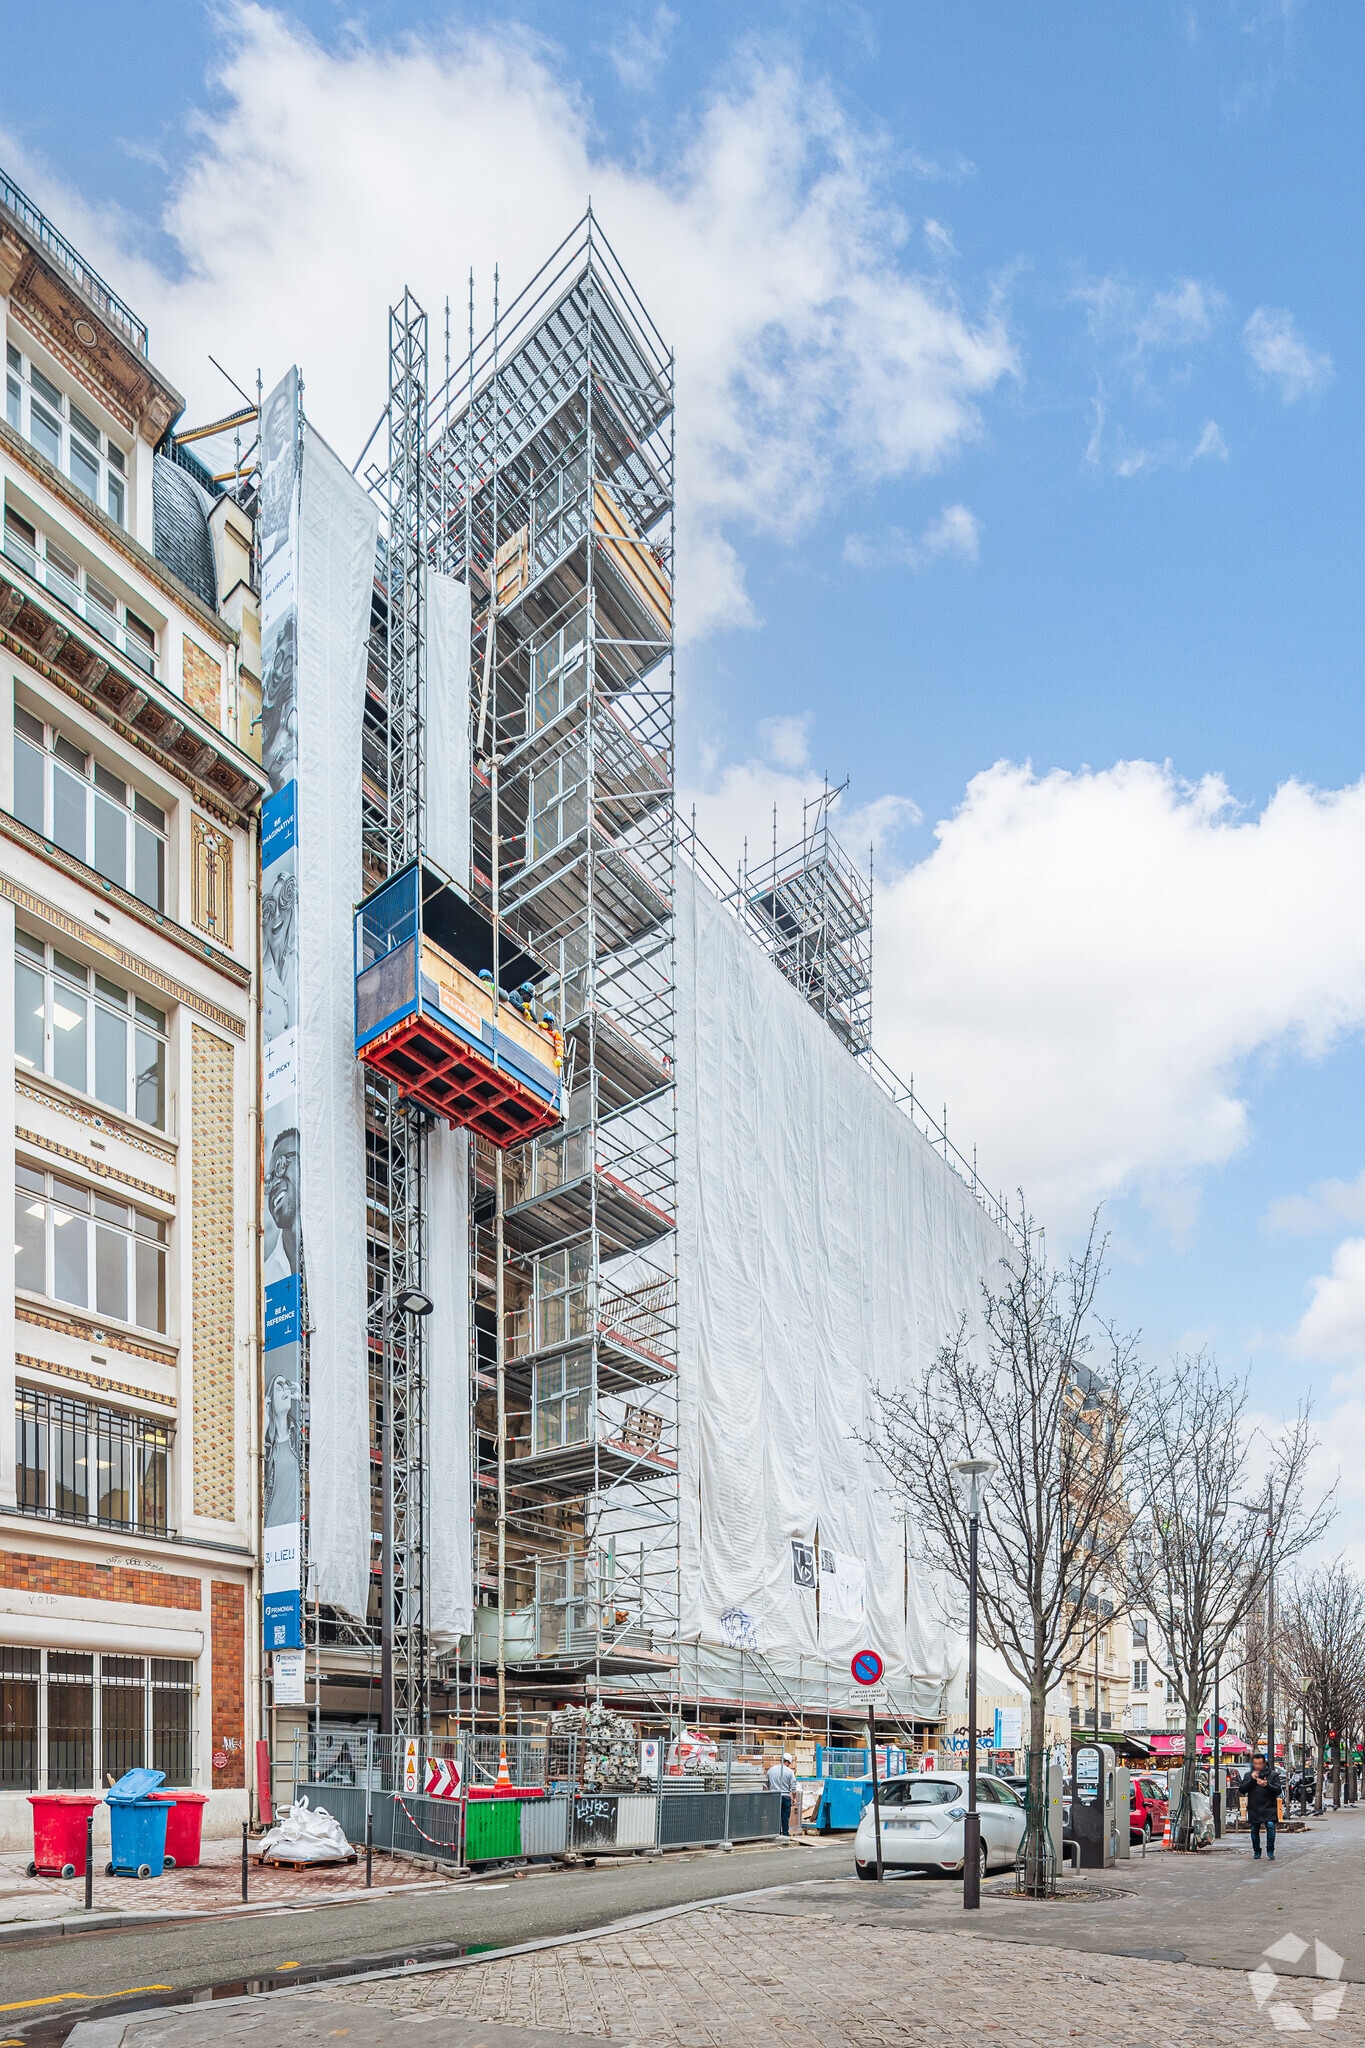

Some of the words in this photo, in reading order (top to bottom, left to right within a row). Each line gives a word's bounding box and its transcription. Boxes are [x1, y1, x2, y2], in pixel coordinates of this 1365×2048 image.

[273, 570, 291, 593] URBAN
[273, 816, 282, 827] BE
[262, 814, 295, 846] IMAGINATIVE
[443, 996, 478, 1025] ALIMAK
[268, 1070, 276, 1080] BE
[276, 1060, 291, 1076] PICKY
[266, 1310, 295, 1328] REFERENCE
[274, 1307, 282, 1316] BE
[274, 1548, 295, 1562] LIEU
[28, 1595, 58, 1605] VOID
[270, 1605, 294, 1613] PRIMONIAL
